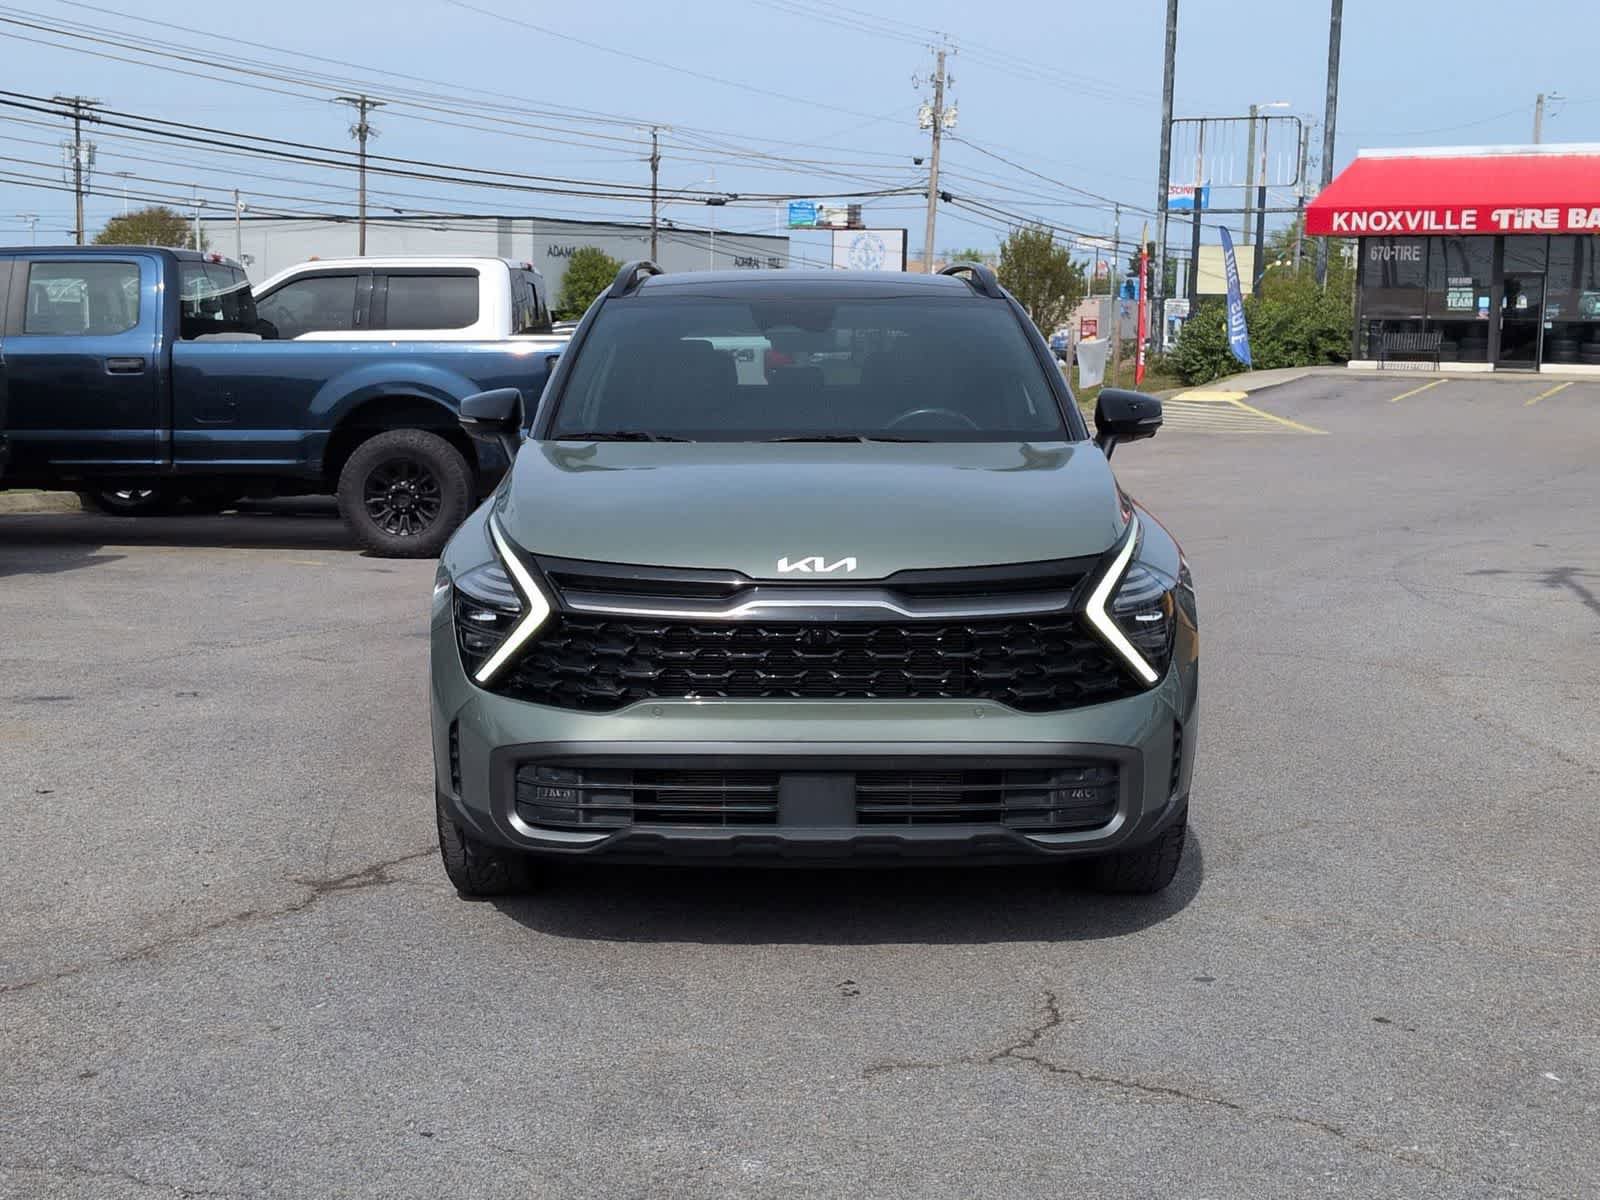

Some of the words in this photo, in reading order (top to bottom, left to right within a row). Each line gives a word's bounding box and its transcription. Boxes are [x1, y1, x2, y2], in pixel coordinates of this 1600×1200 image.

[1332, 209, 1478, 231] KNOXVILLE
[1370, 246, 1421, 261] 670-TIRE
[777, 556, 857, 573] KIA
